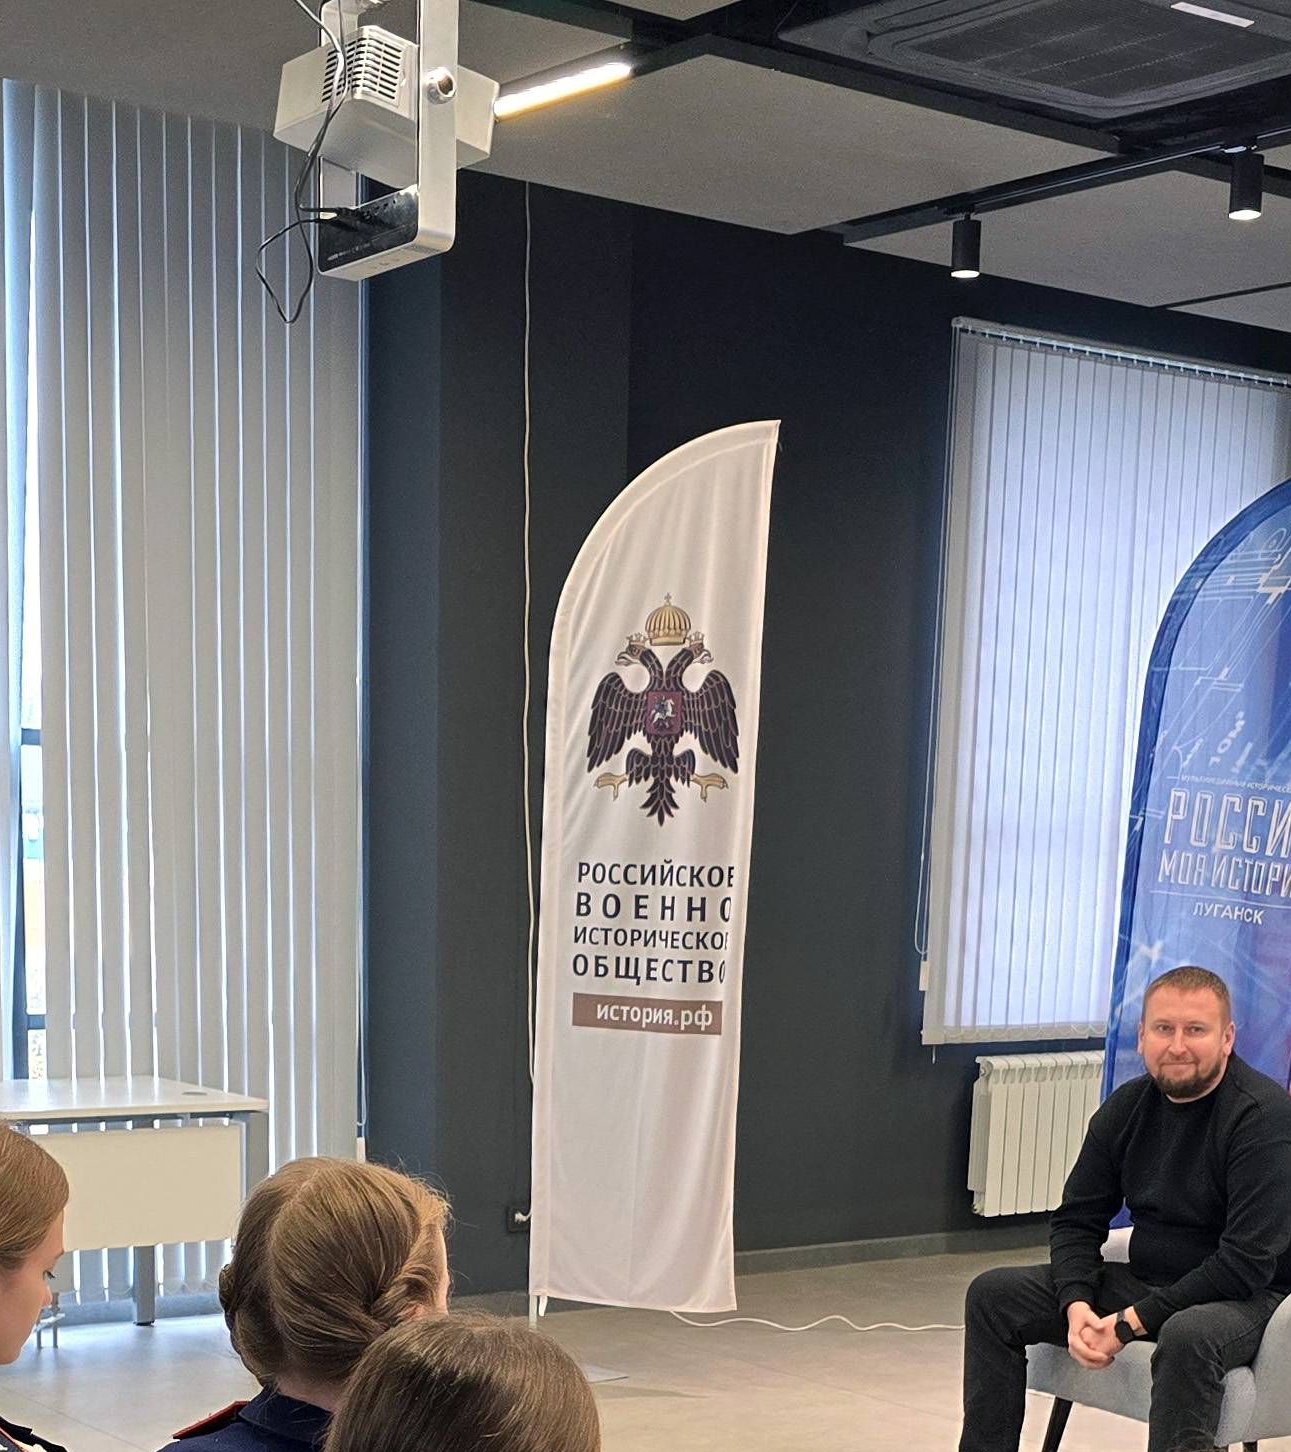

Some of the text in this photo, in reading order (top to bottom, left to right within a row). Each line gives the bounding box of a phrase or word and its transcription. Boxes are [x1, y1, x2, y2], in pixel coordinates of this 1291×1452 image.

[1158, 849, 1207, 886] МОЯ
[1193, 902, 1264, 925] ЛУГАНСК
[573, 926, 728, 950] ИСТОРИЧЕСКО
[596, 1003, 713, 1031] история.рф
